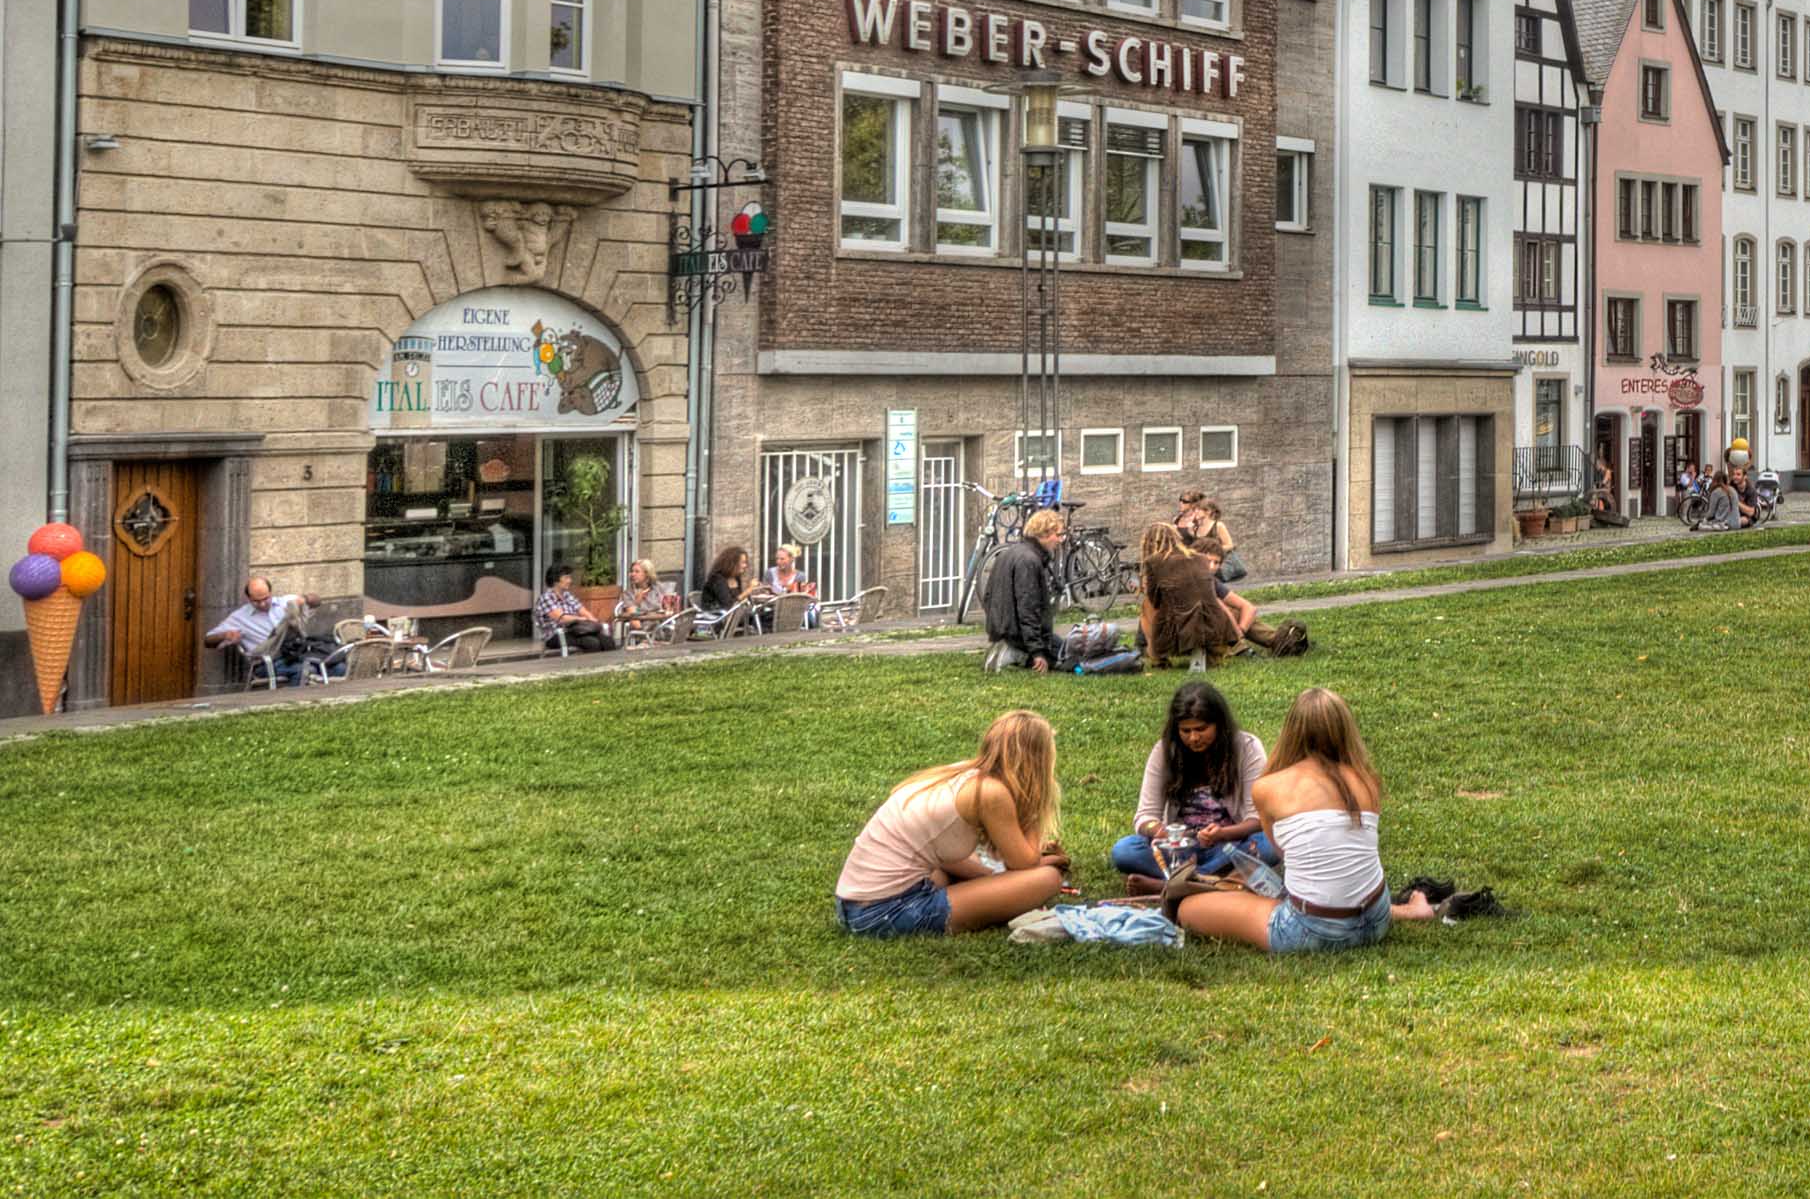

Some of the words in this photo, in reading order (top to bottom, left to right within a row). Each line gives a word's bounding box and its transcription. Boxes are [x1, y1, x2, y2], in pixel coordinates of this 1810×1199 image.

[708, 252, 728, 273] EIS
[463, 308, 510, 326] EIGENE
[437, 335, 531, 353] HERSTELLUNG
[1512, 350, 1559, 367] NGOLD
[435, 378, 474, 413] EIS
